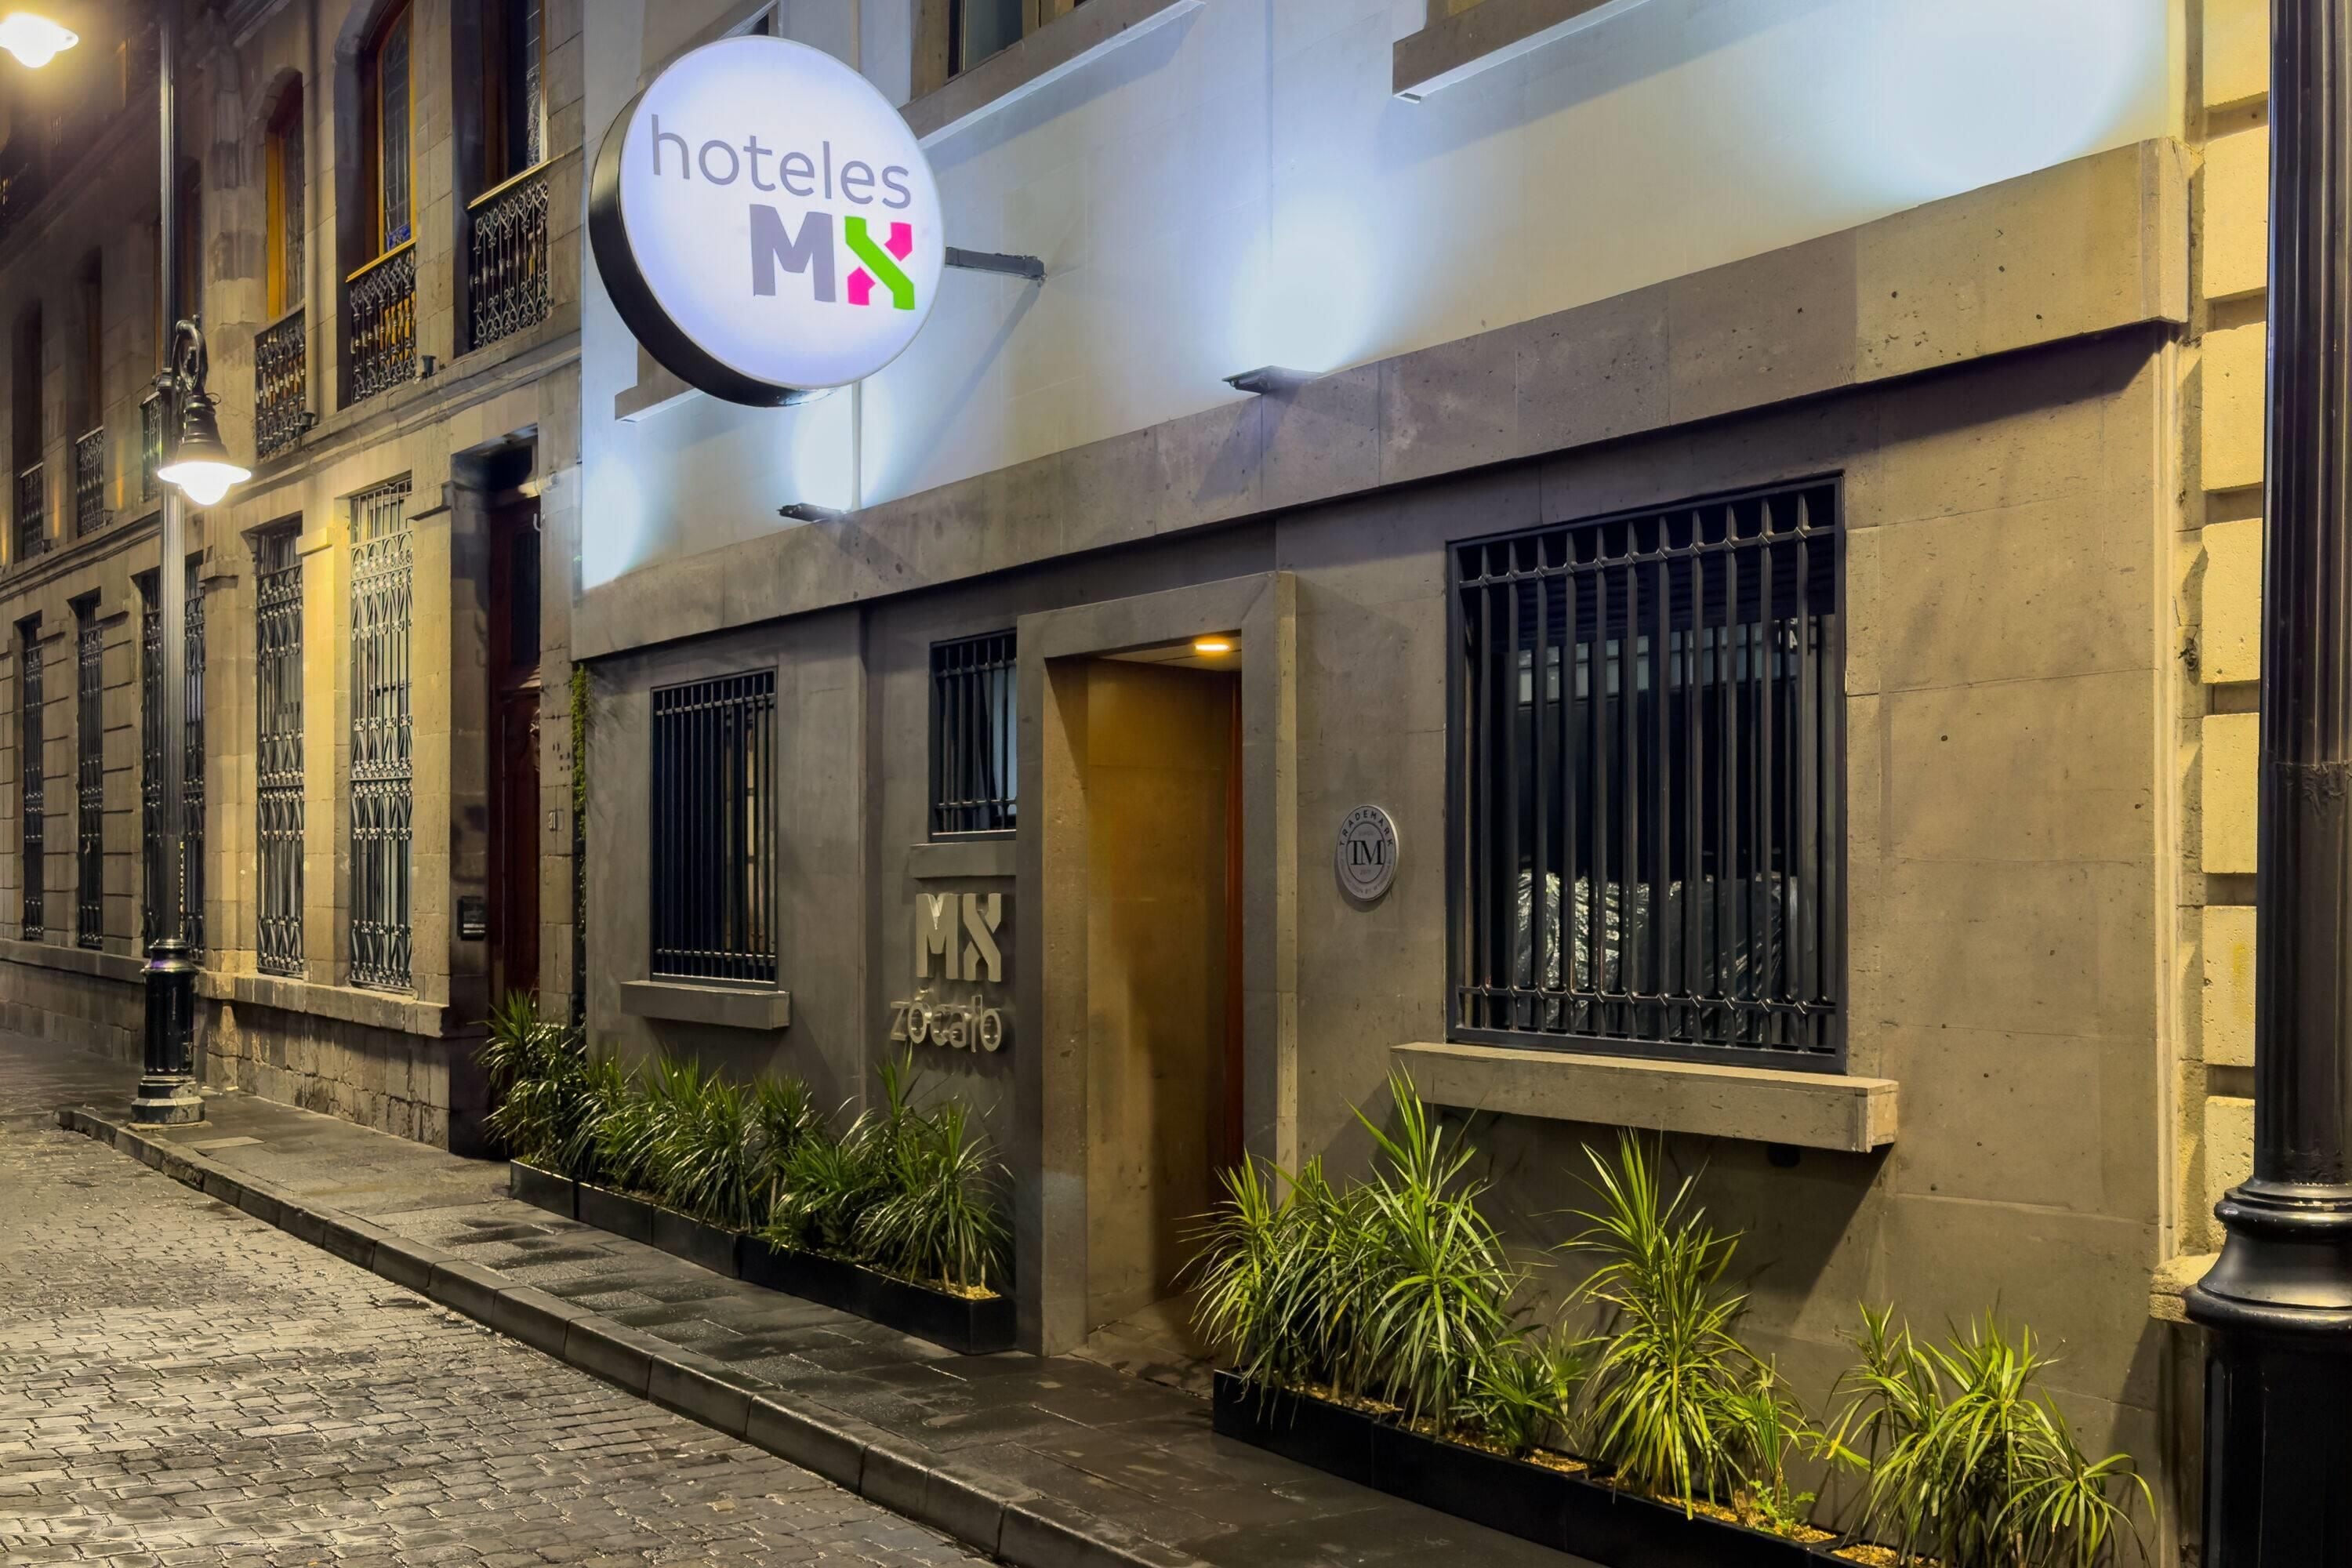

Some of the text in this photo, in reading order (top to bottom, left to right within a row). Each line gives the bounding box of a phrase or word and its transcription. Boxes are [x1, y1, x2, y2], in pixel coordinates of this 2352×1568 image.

[651, 114, 912, 209] hoteles
[749, 203, 916, 310] MX
[1339, 810, 1394, 847] TRADEMARK
[916, 892, 1002, 982] MX
